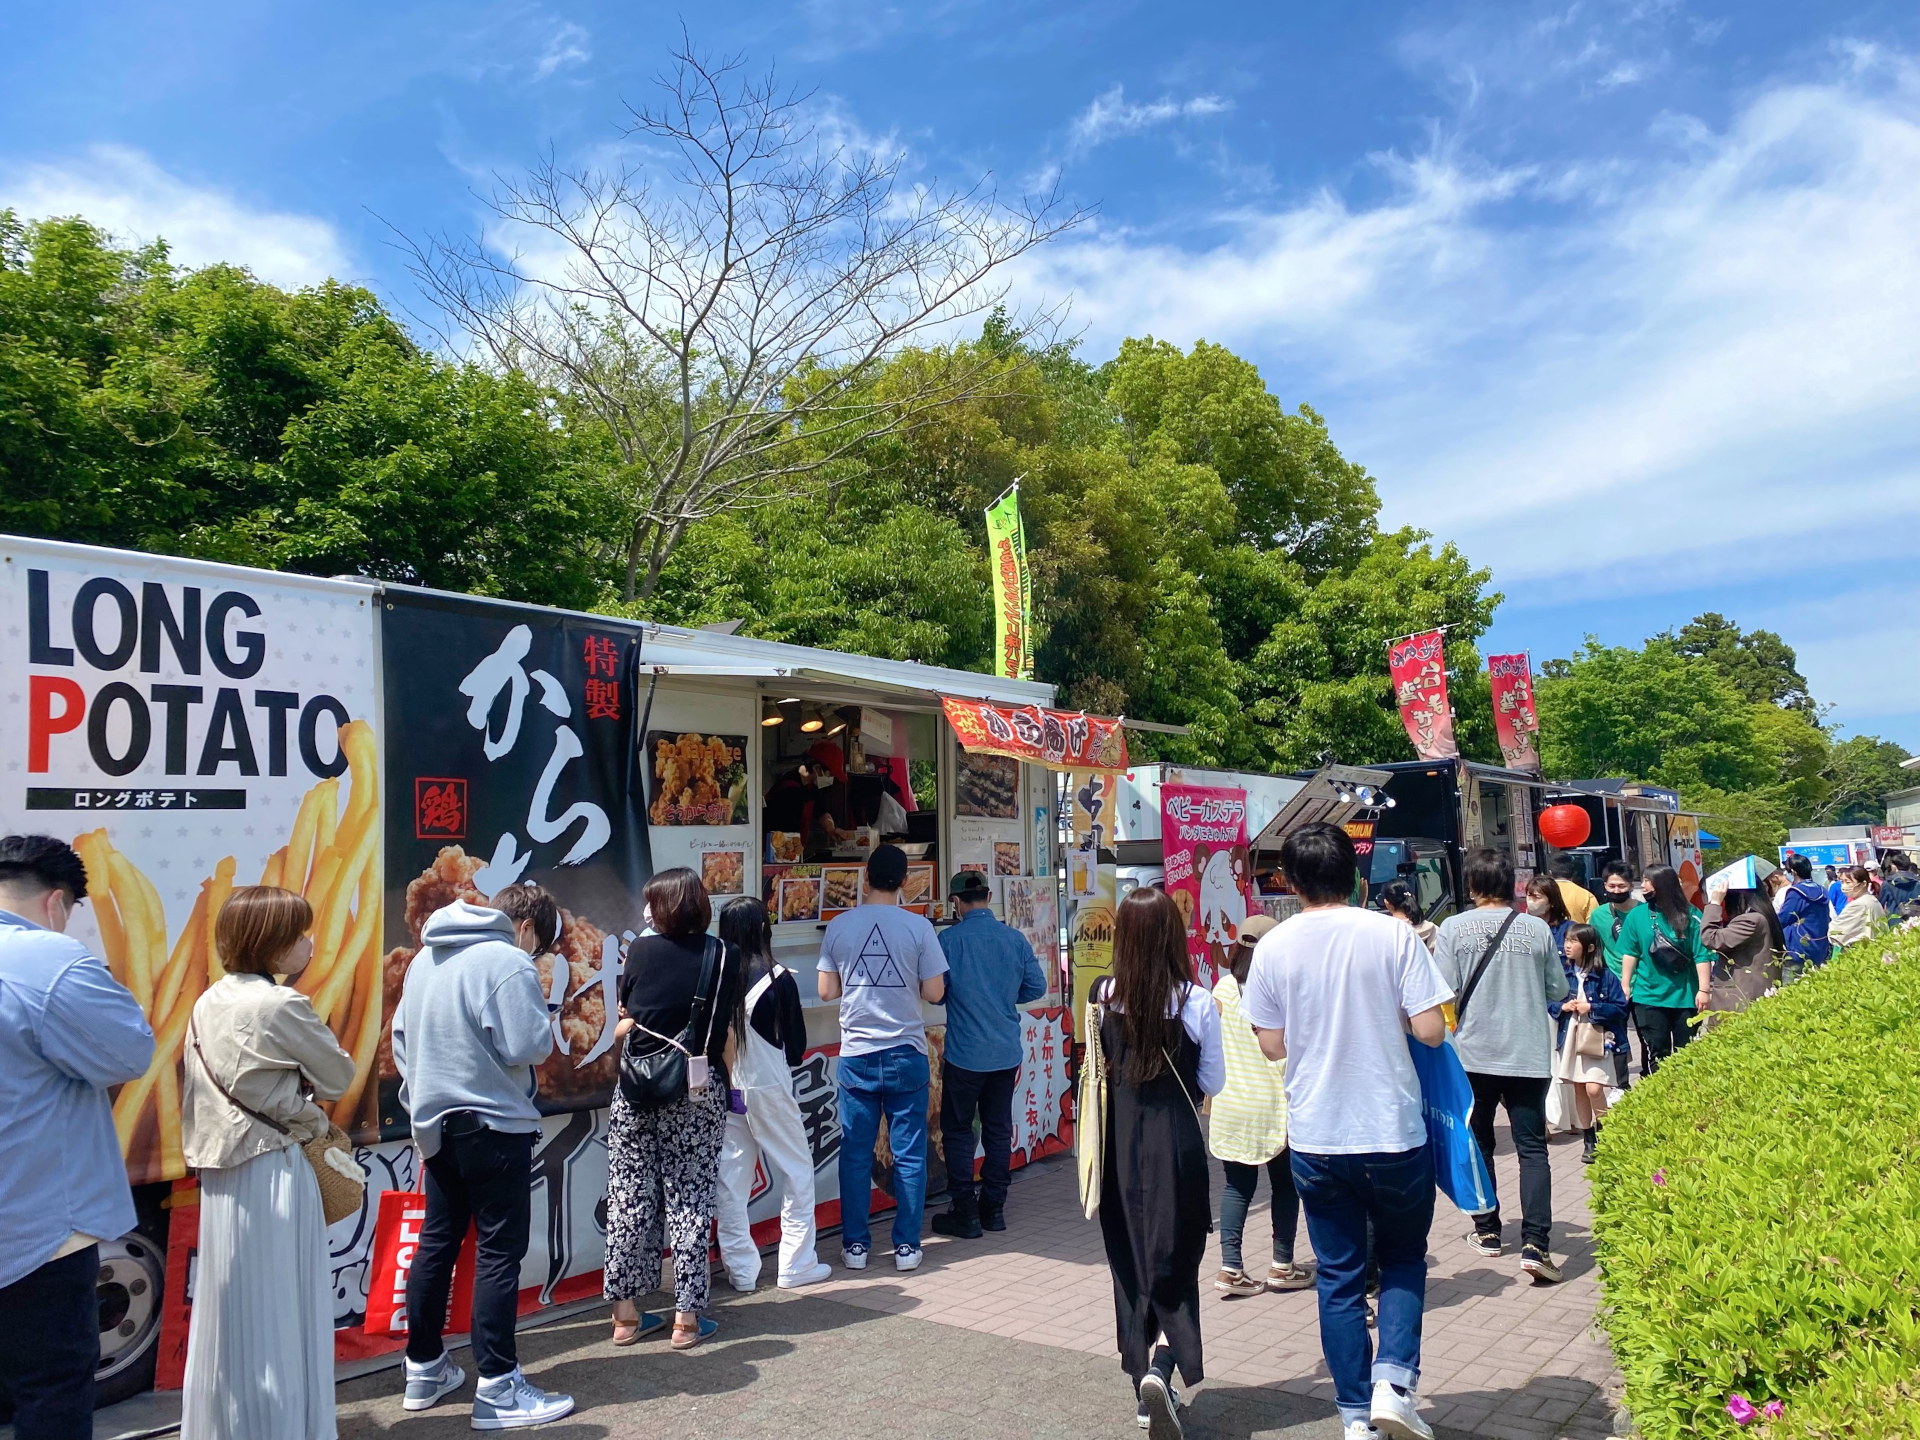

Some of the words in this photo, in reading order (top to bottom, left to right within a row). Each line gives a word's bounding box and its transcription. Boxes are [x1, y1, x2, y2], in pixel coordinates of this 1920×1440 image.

[27, 568, 266, 680] LONG
[584, 634, 621, 721] 特製
[27, 675, 352, 780] POTATO
[74, 790, 199, 807] ロングポテト
[1166, 796, 1245, 824] ベビーカステラ
[1343, 823, 1374, 837] REMIUM
[1167, 863, 1194, 886] おいしい
[872, 939, 878, 947] H
[1073, 923, 1112, 943] Asahi
[1087, 943, 1095, 951] 生
[1476, 936, 1532, 955] BNES
[887, 970, 893, 978] F
[1025, 1025, 1039, 1148] が入った衣が
[1041, 1025, 1054, 1132] 草加せんべい
